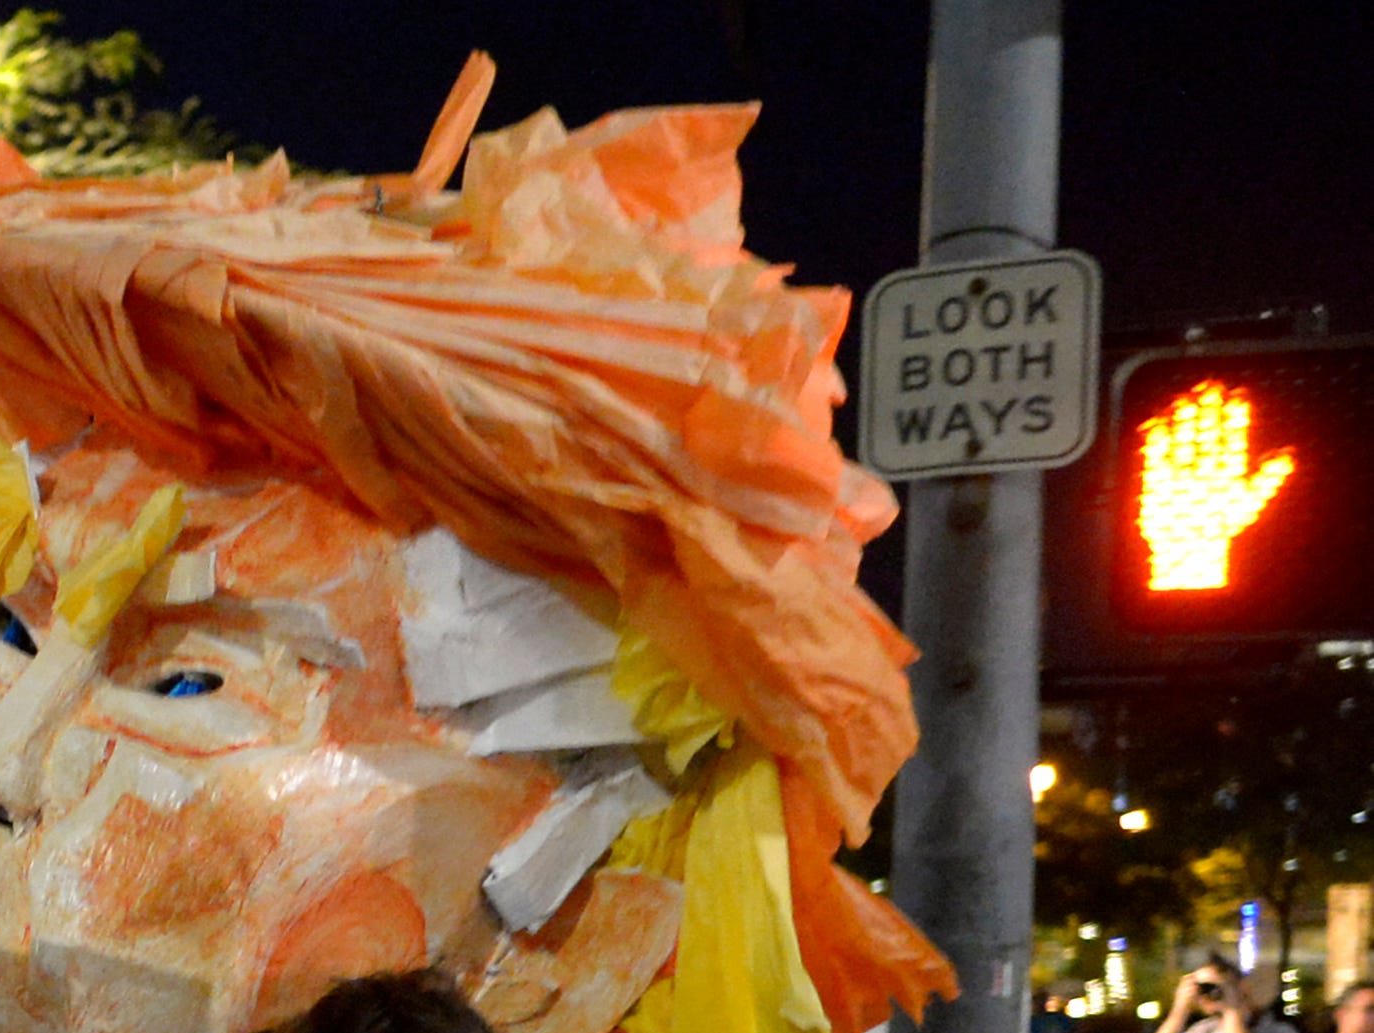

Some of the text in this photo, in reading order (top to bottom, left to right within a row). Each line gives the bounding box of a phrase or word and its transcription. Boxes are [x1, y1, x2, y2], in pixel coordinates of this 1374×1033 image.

[903, 284, 1060, 341] LOOK
[900, 341, 1055, 394] BOTH
[894, 395, 1056, 446] WAYS
